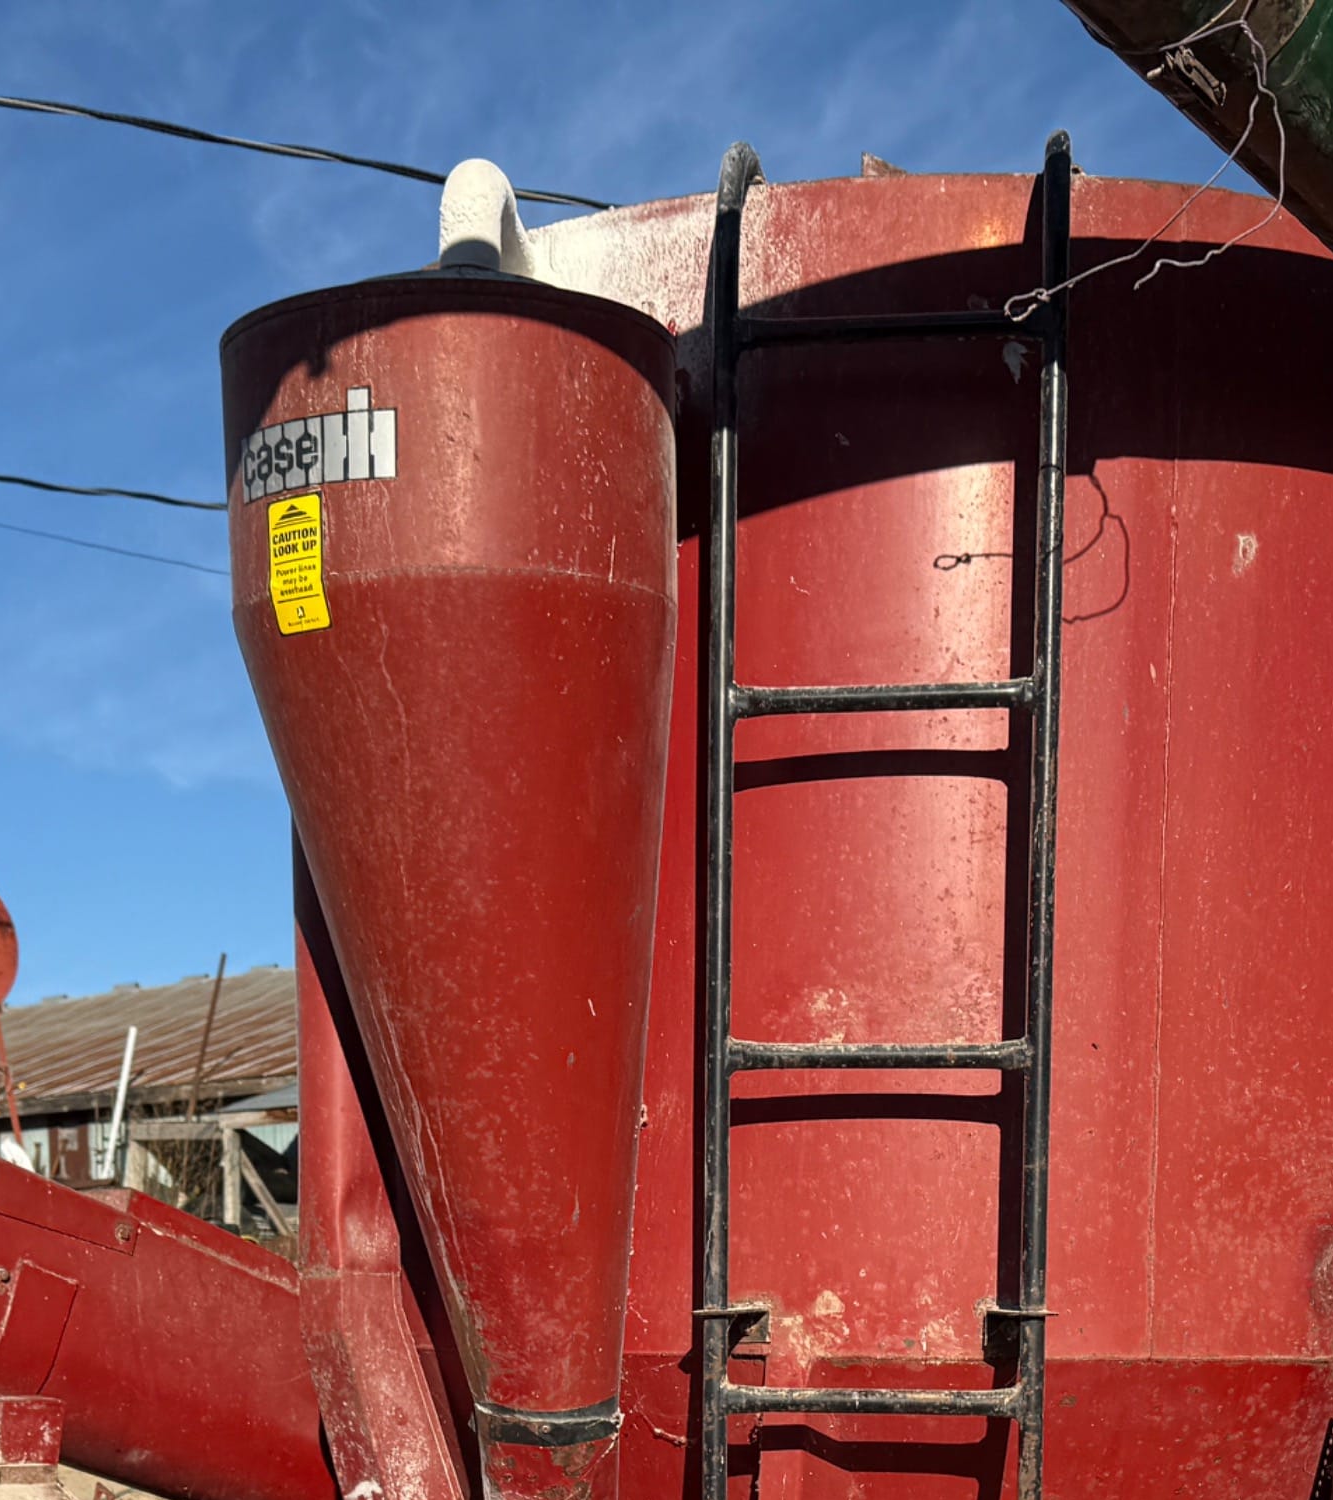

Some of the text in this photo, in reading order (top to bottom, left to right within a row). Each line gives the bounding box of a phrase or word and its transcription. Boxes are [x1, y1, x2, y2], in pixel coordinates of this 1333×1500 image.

[272, 527, 317, 545] CAUTION
[273, 540, 317, 558] LOOK UP
[275, 567, 297, 578] Power
[282, 577, 297, 586] may
[280, 583, 313, 597] overhead
